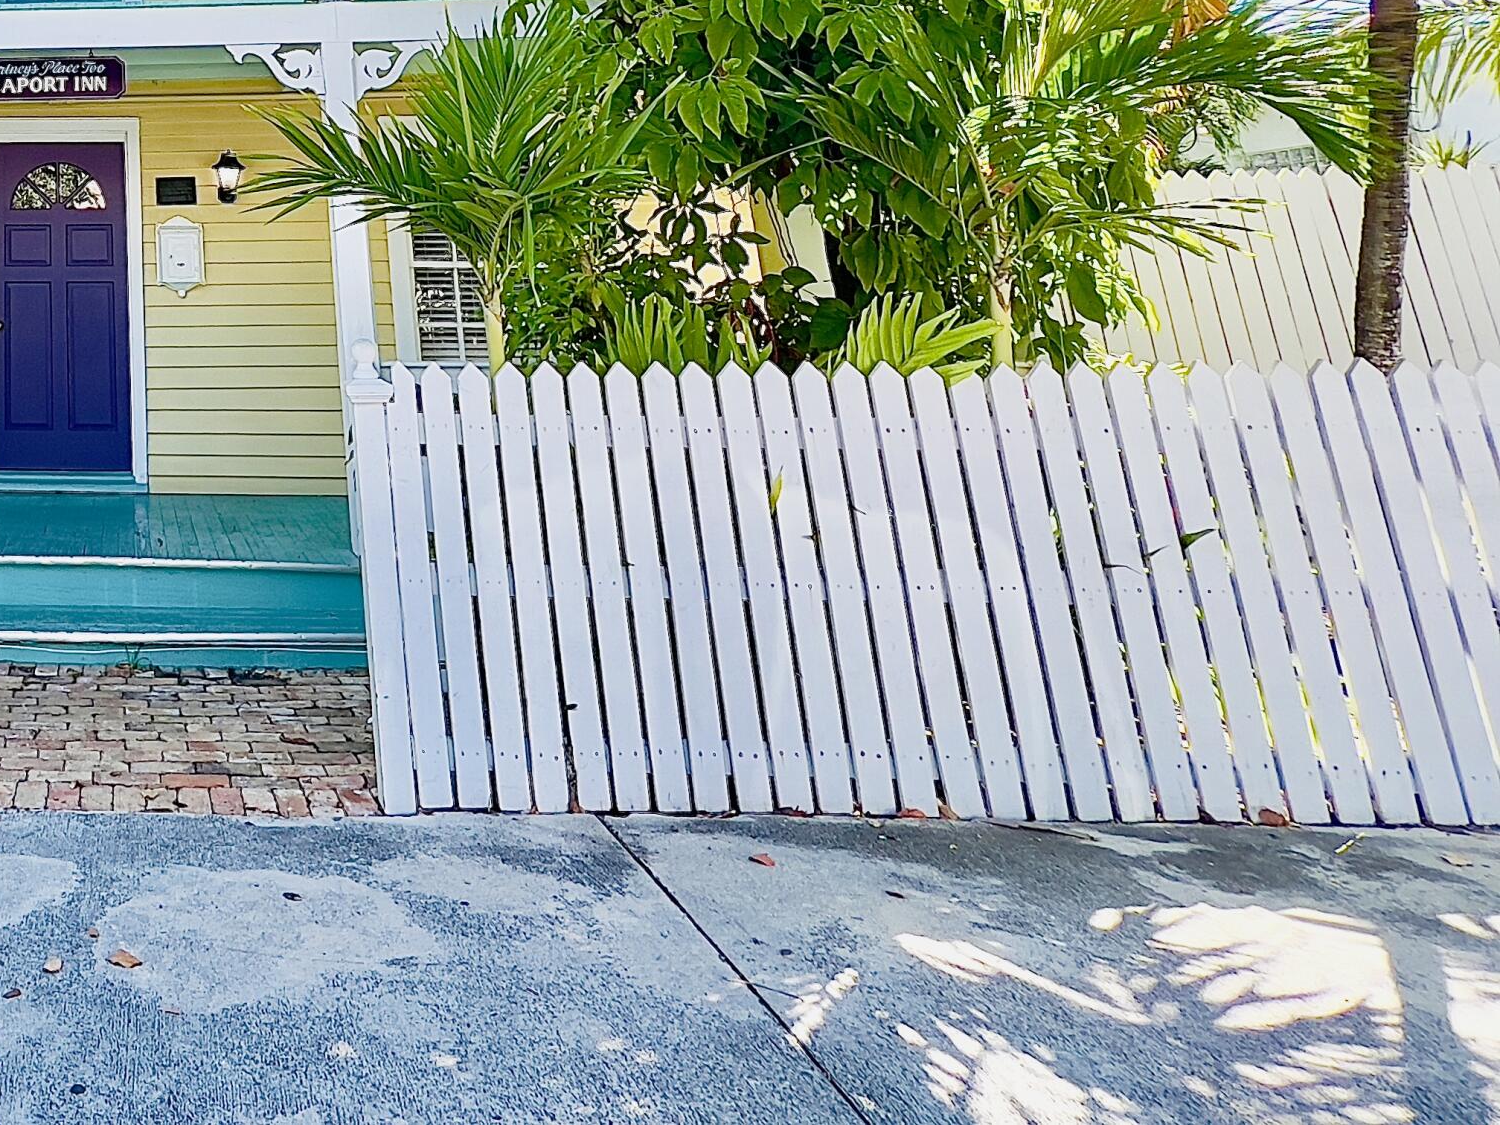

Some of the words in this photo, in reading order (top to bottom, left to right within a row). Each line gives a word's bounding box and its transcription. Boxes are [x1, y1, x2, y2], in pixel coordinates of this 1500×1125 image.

[40, 60, 80, 76] Place
[81, 60, 106, 74] Too
[74, 76, 108, 92] INN
